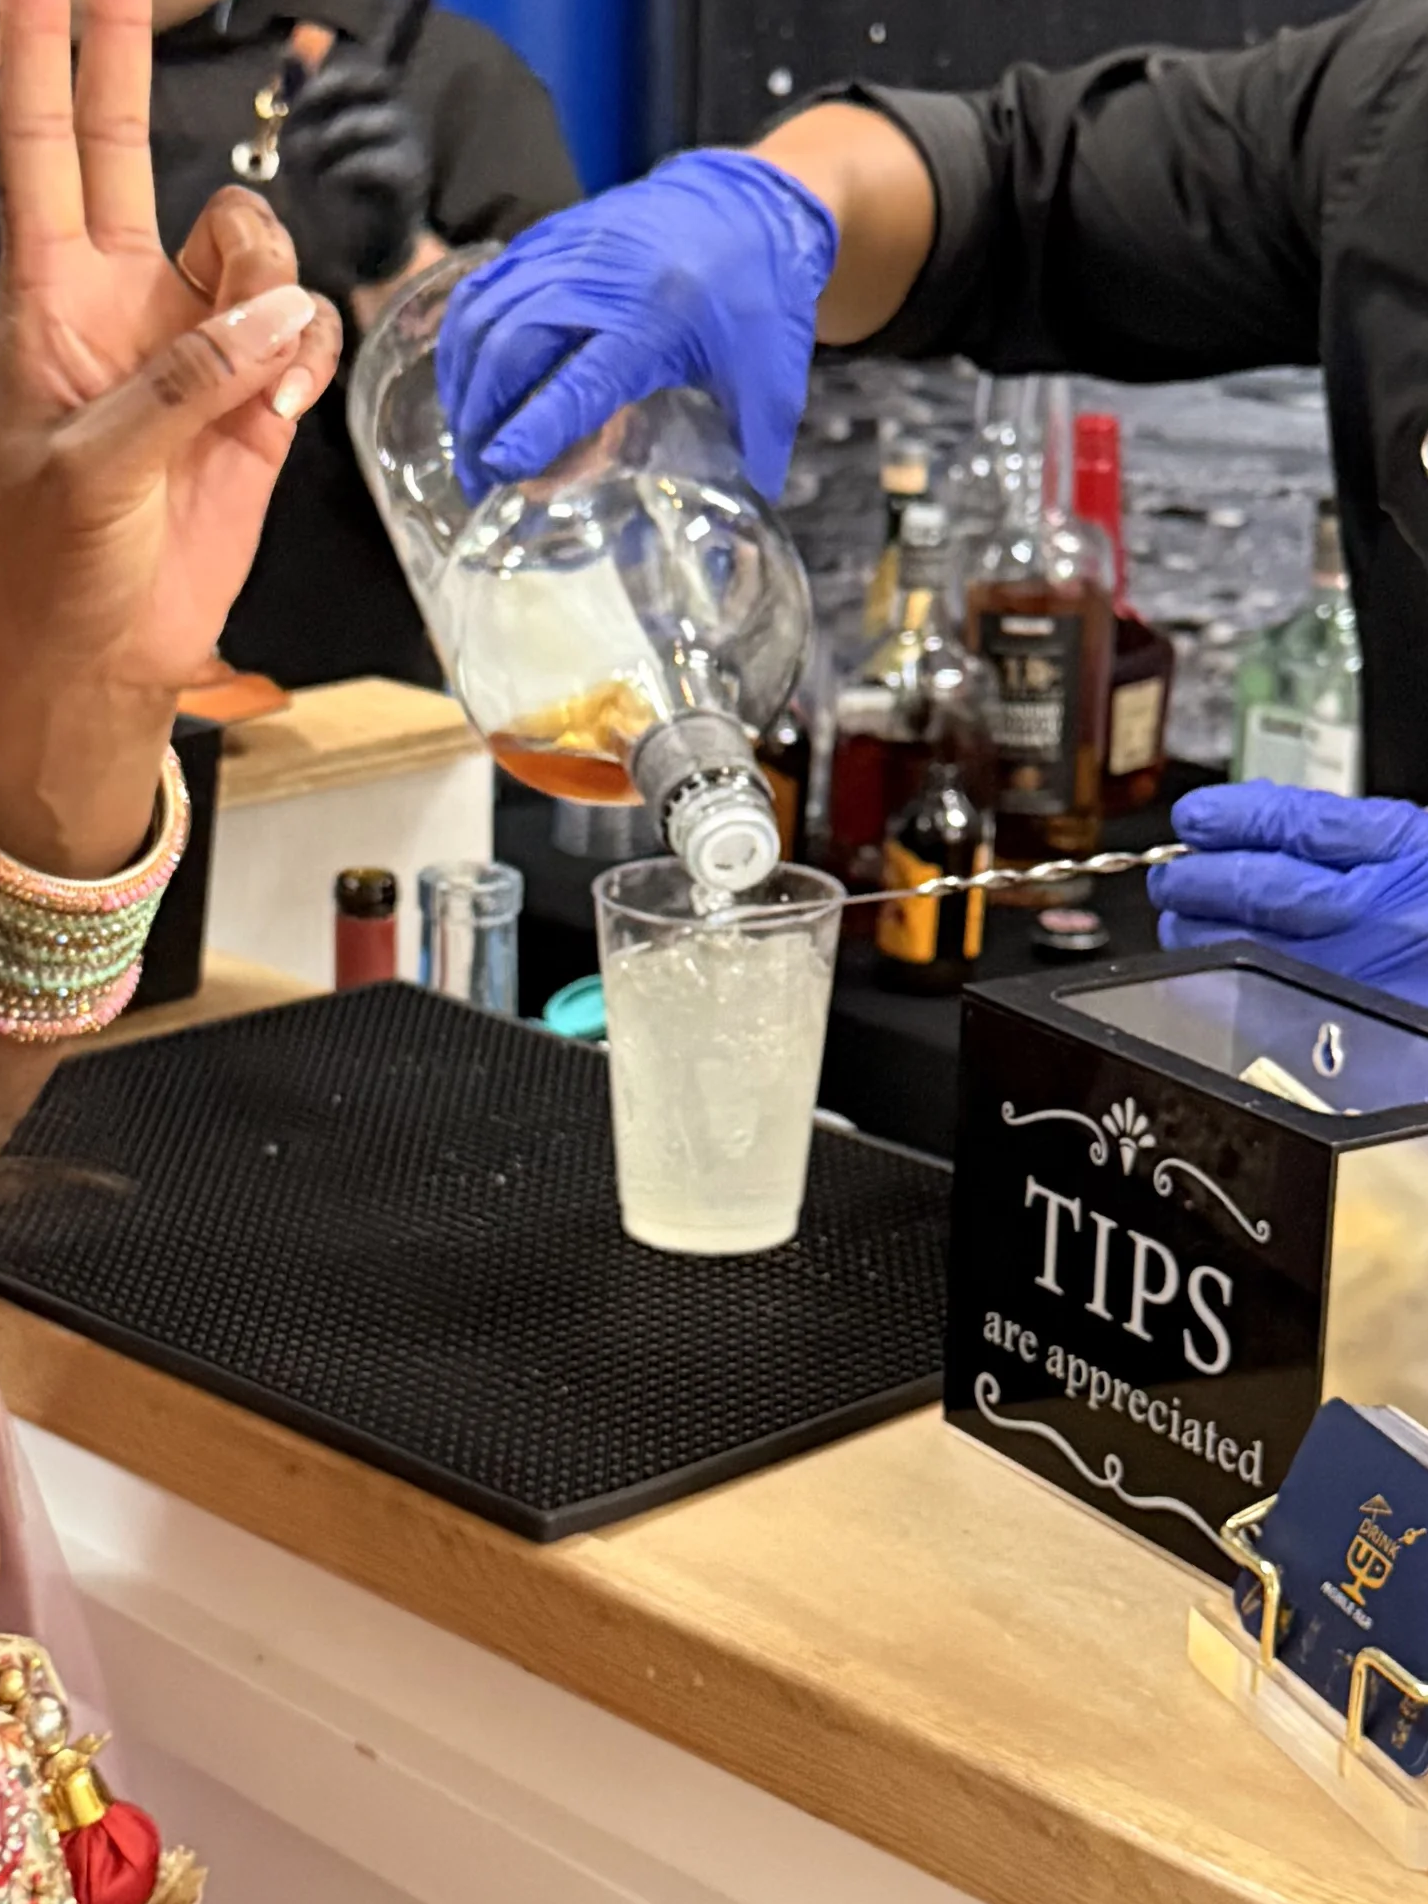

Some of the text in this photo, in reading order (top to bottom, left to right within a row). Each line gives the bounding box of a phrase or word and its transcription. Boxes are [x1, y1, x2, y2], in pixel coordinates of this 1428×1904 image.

[1024, 1174, 1233, 1375] TIPS
[983, 1311, 1264, 1488] are appreciated
[1351, 1540, 1386, 1580] UP
[1358, 1518, 1402, 1560] DRINK
